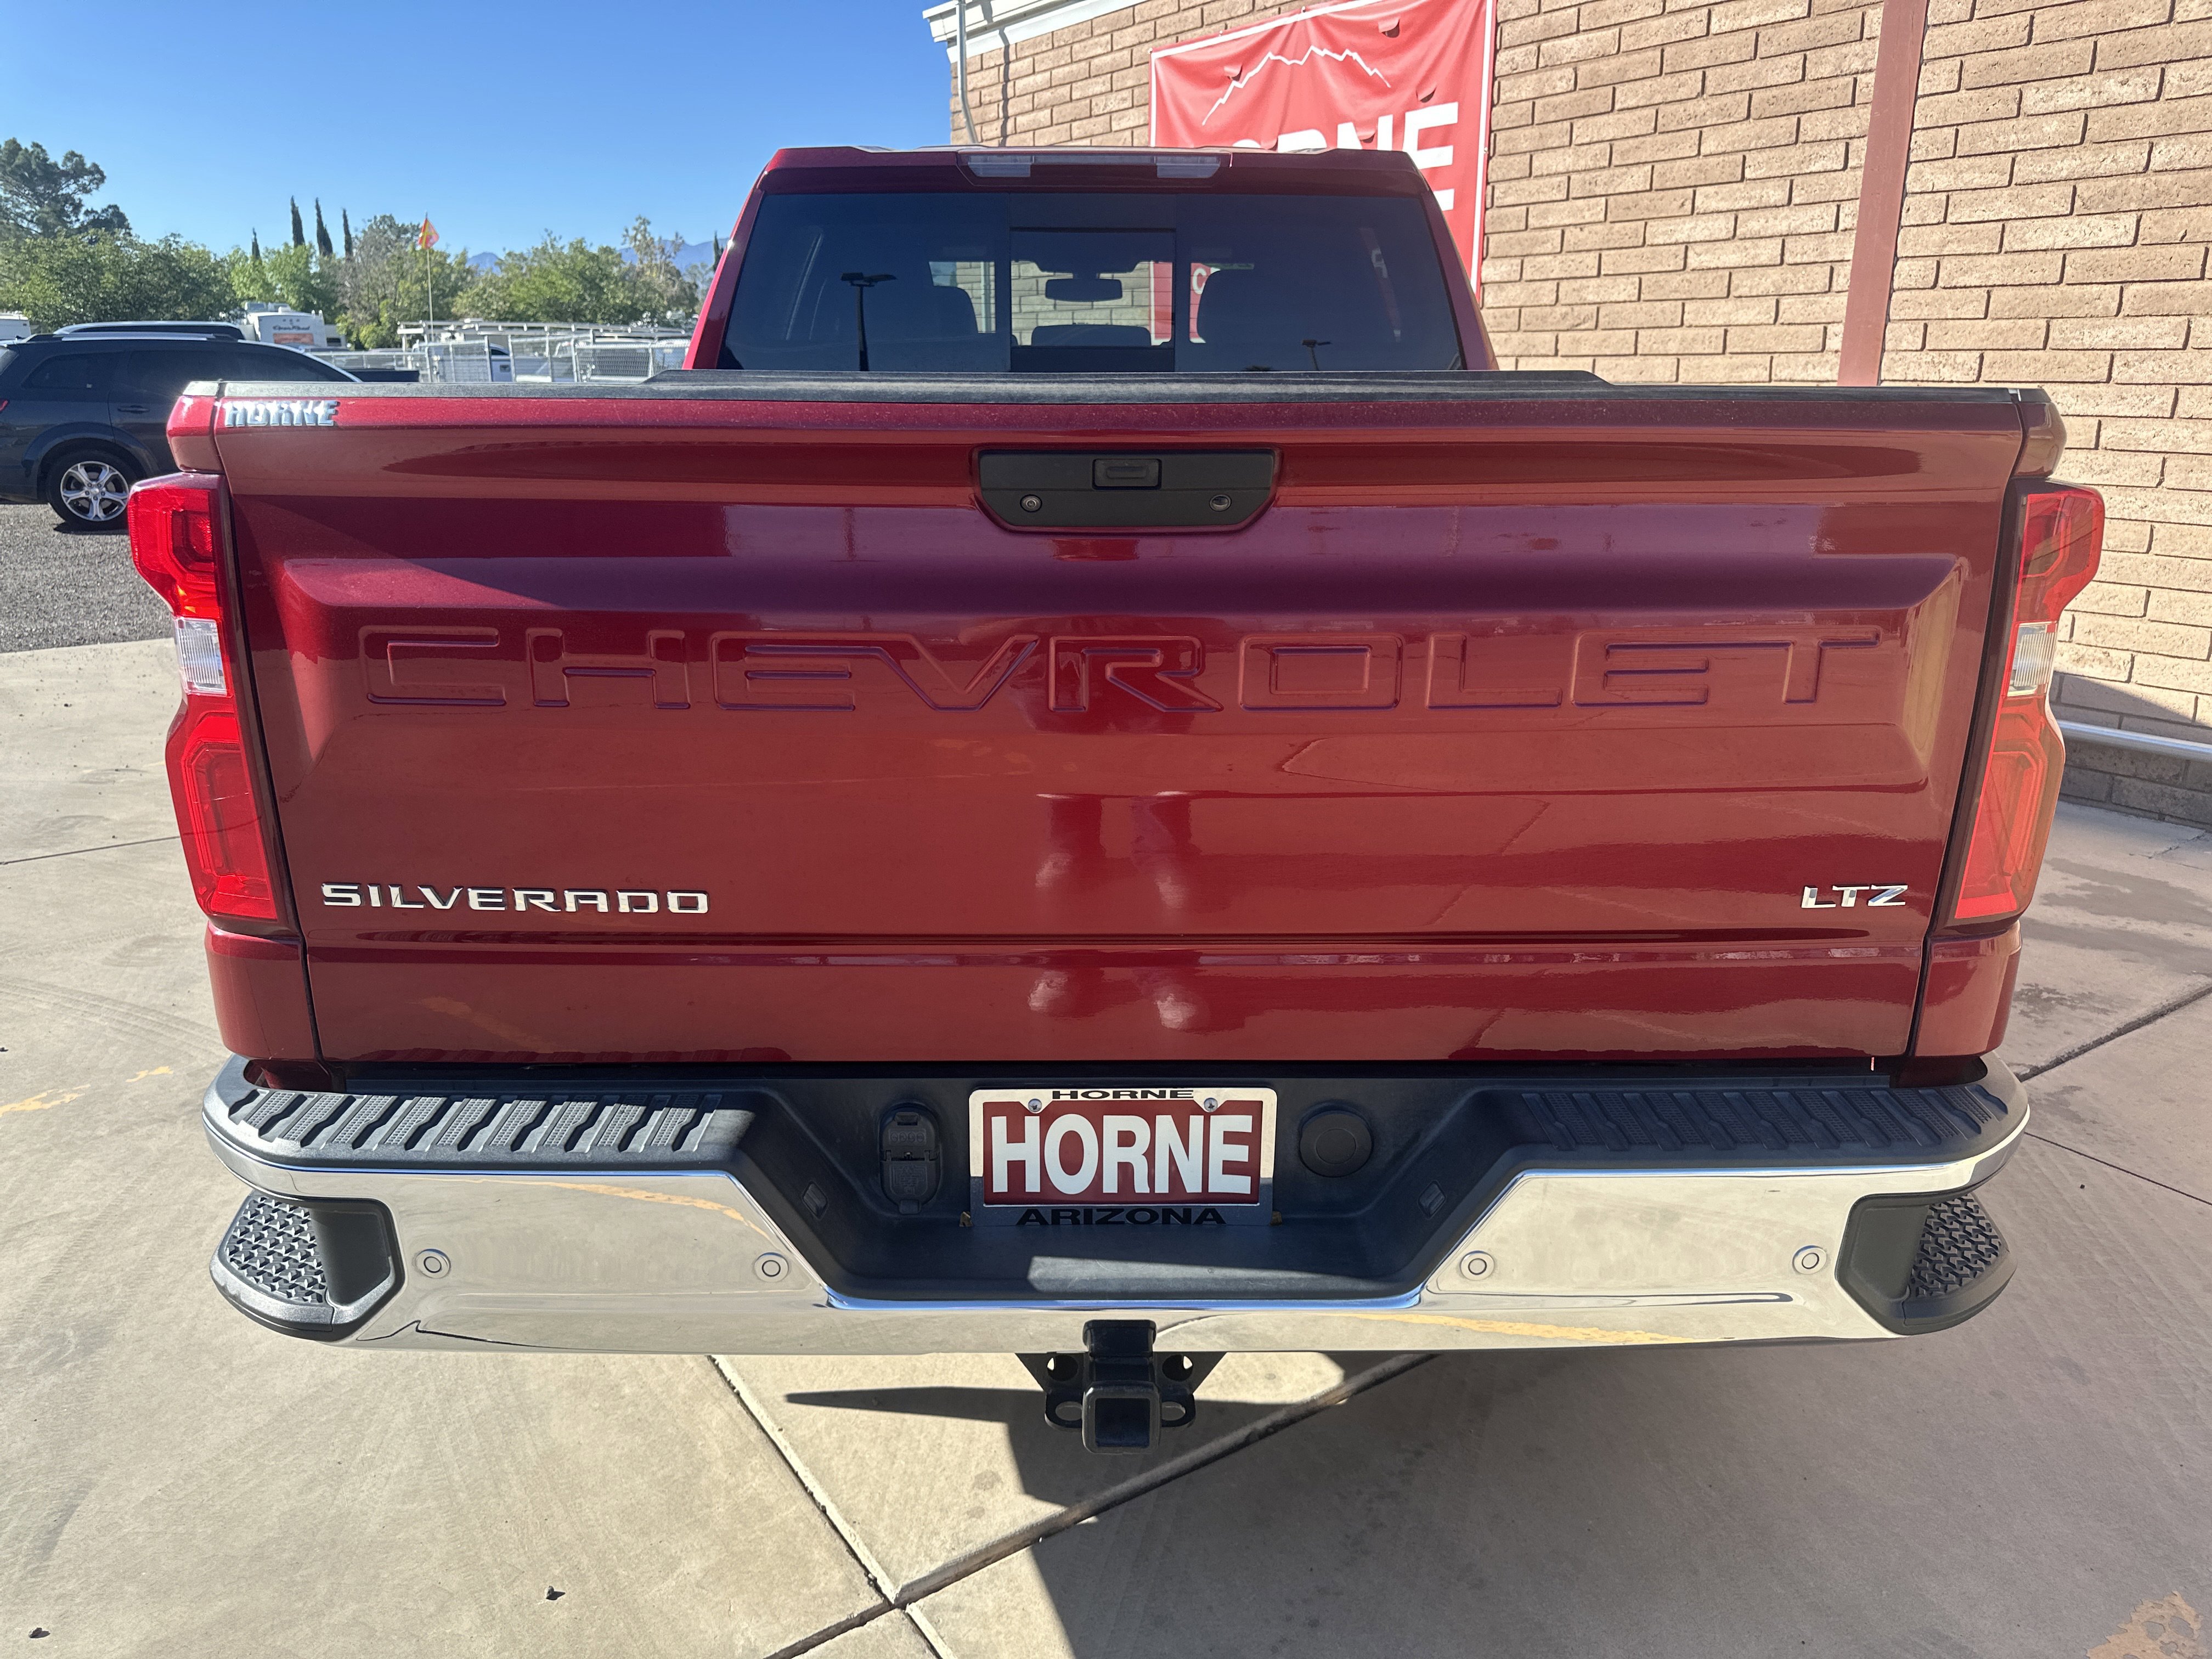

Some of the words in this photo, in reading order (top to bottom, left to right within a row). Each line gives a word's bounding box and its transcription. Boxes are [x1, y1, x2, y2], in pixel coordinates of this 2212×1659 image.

[358, 625, 1882, 713] CHEVROLET
[321, 883, 709, 913] SILVERADO
[1801, 884, 1908, 909] LTZ
[1052, 1090, 1194, 1099] HORNE
[991, 1113, 1252, 1195] HORNE
[1015, 1207, 1227, 1226] ARIZONA
